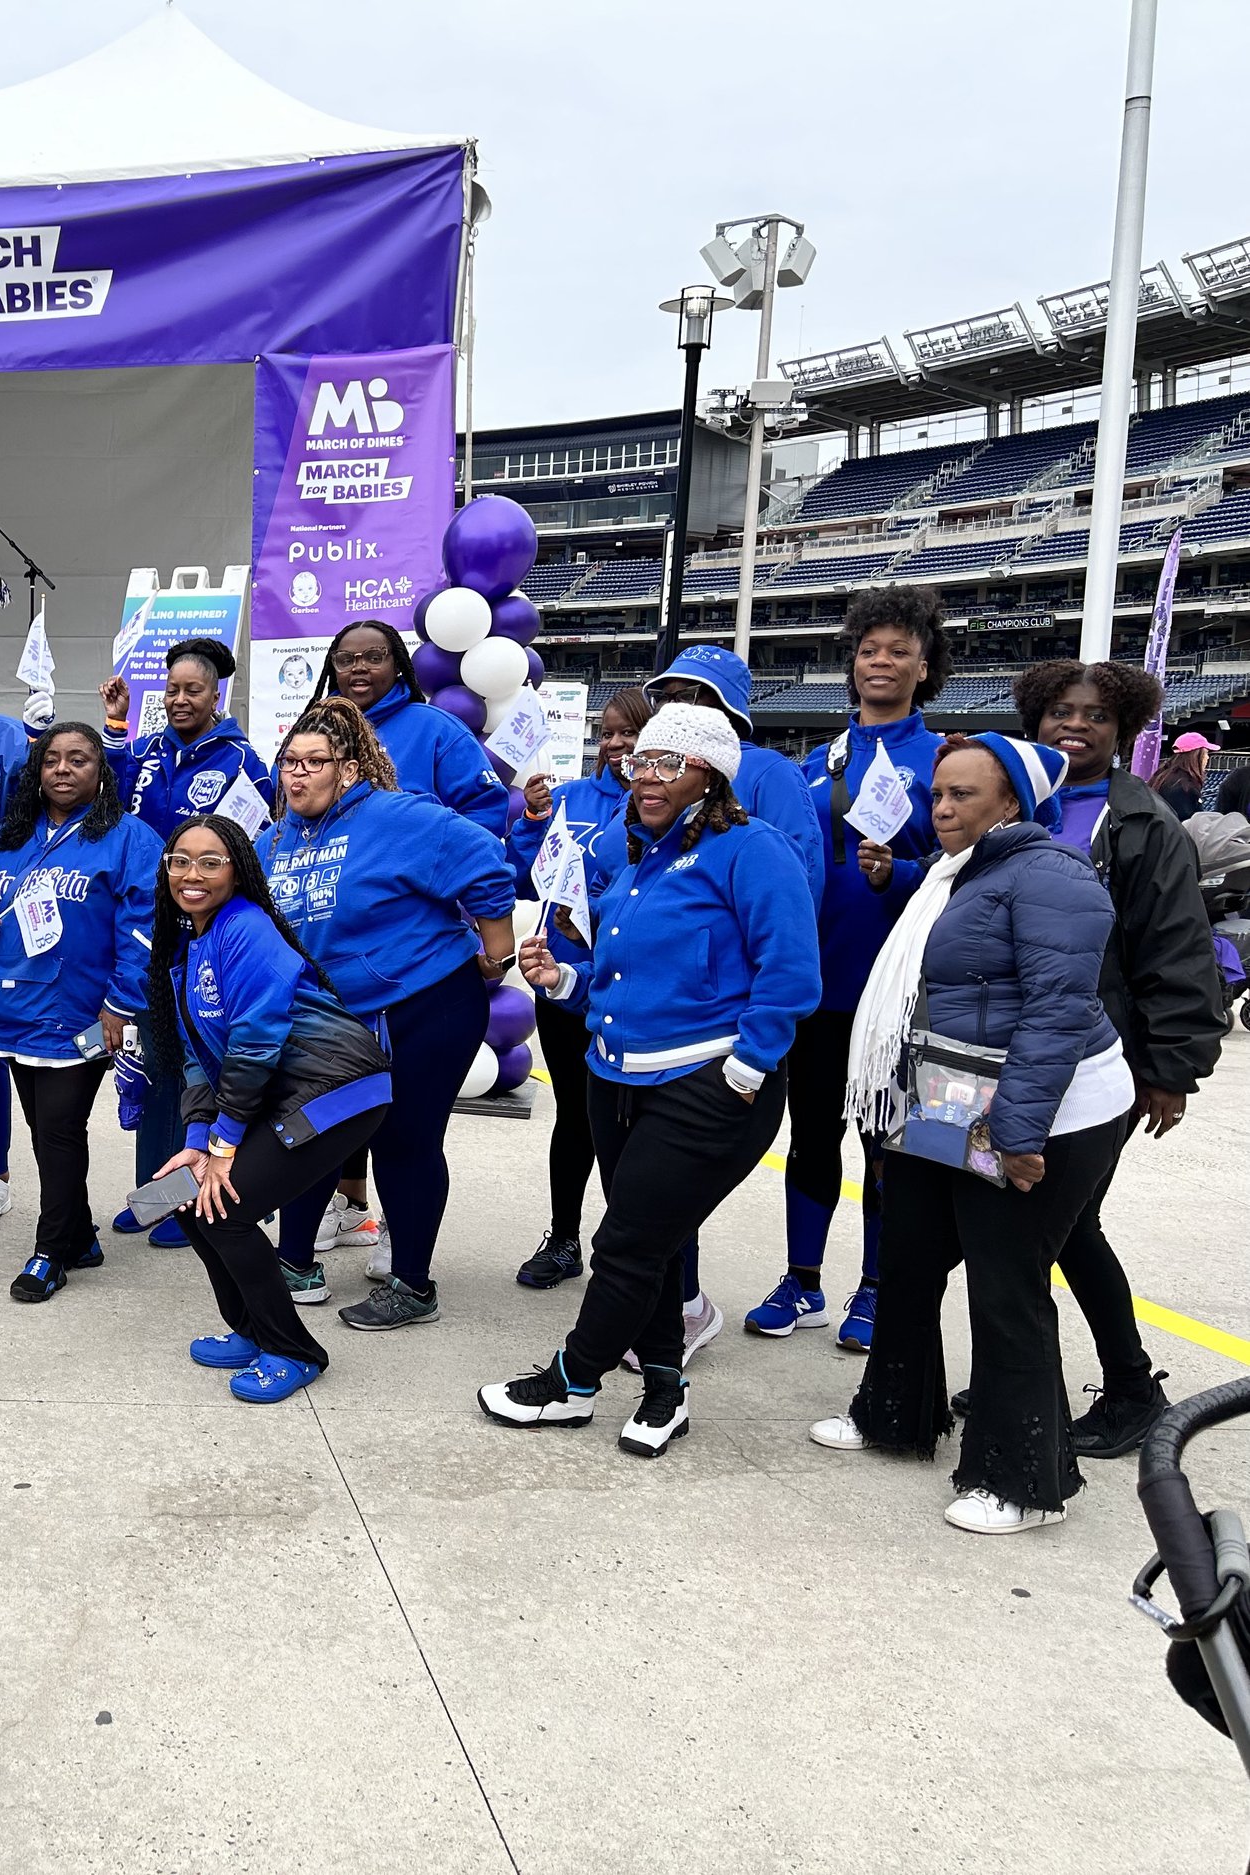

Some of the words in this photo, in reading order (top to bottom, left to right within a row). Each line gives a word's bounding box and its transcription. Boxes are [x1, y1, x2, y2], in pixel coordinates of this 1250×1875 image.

[306, 439, 347, 450] MARCH
[350, 437, 365, 449] OF
[306, 463, 380, 480] MARCH
[306, 486, 327, 495] FOR
[334, 481, 403, 500] BABIES
[290, 524, 318, 532] National
[318, 523, 346, 531] Partners
[345, 579, 393, 599] HCA
[147, 610, 174, 620] ELING
[177, 609, 228, 619] INSPIRED?
[291, 606, 319, 614] Gerber
[987, 619, 1029, 629] CHAMPIONS
[1031, 617, 1050, 626] CLUB
[157, 627, 177, 636] here
[191, 627, 222, 635] donate
[146, 651, 167, 660] supp
[273, 646, 309, 654] Presenting
[130, 661, 143, 669] for
[145, 661, 159, 669] the
[310, 888, 333, 902] 100%
[795, 1297, 811, 1315] N
